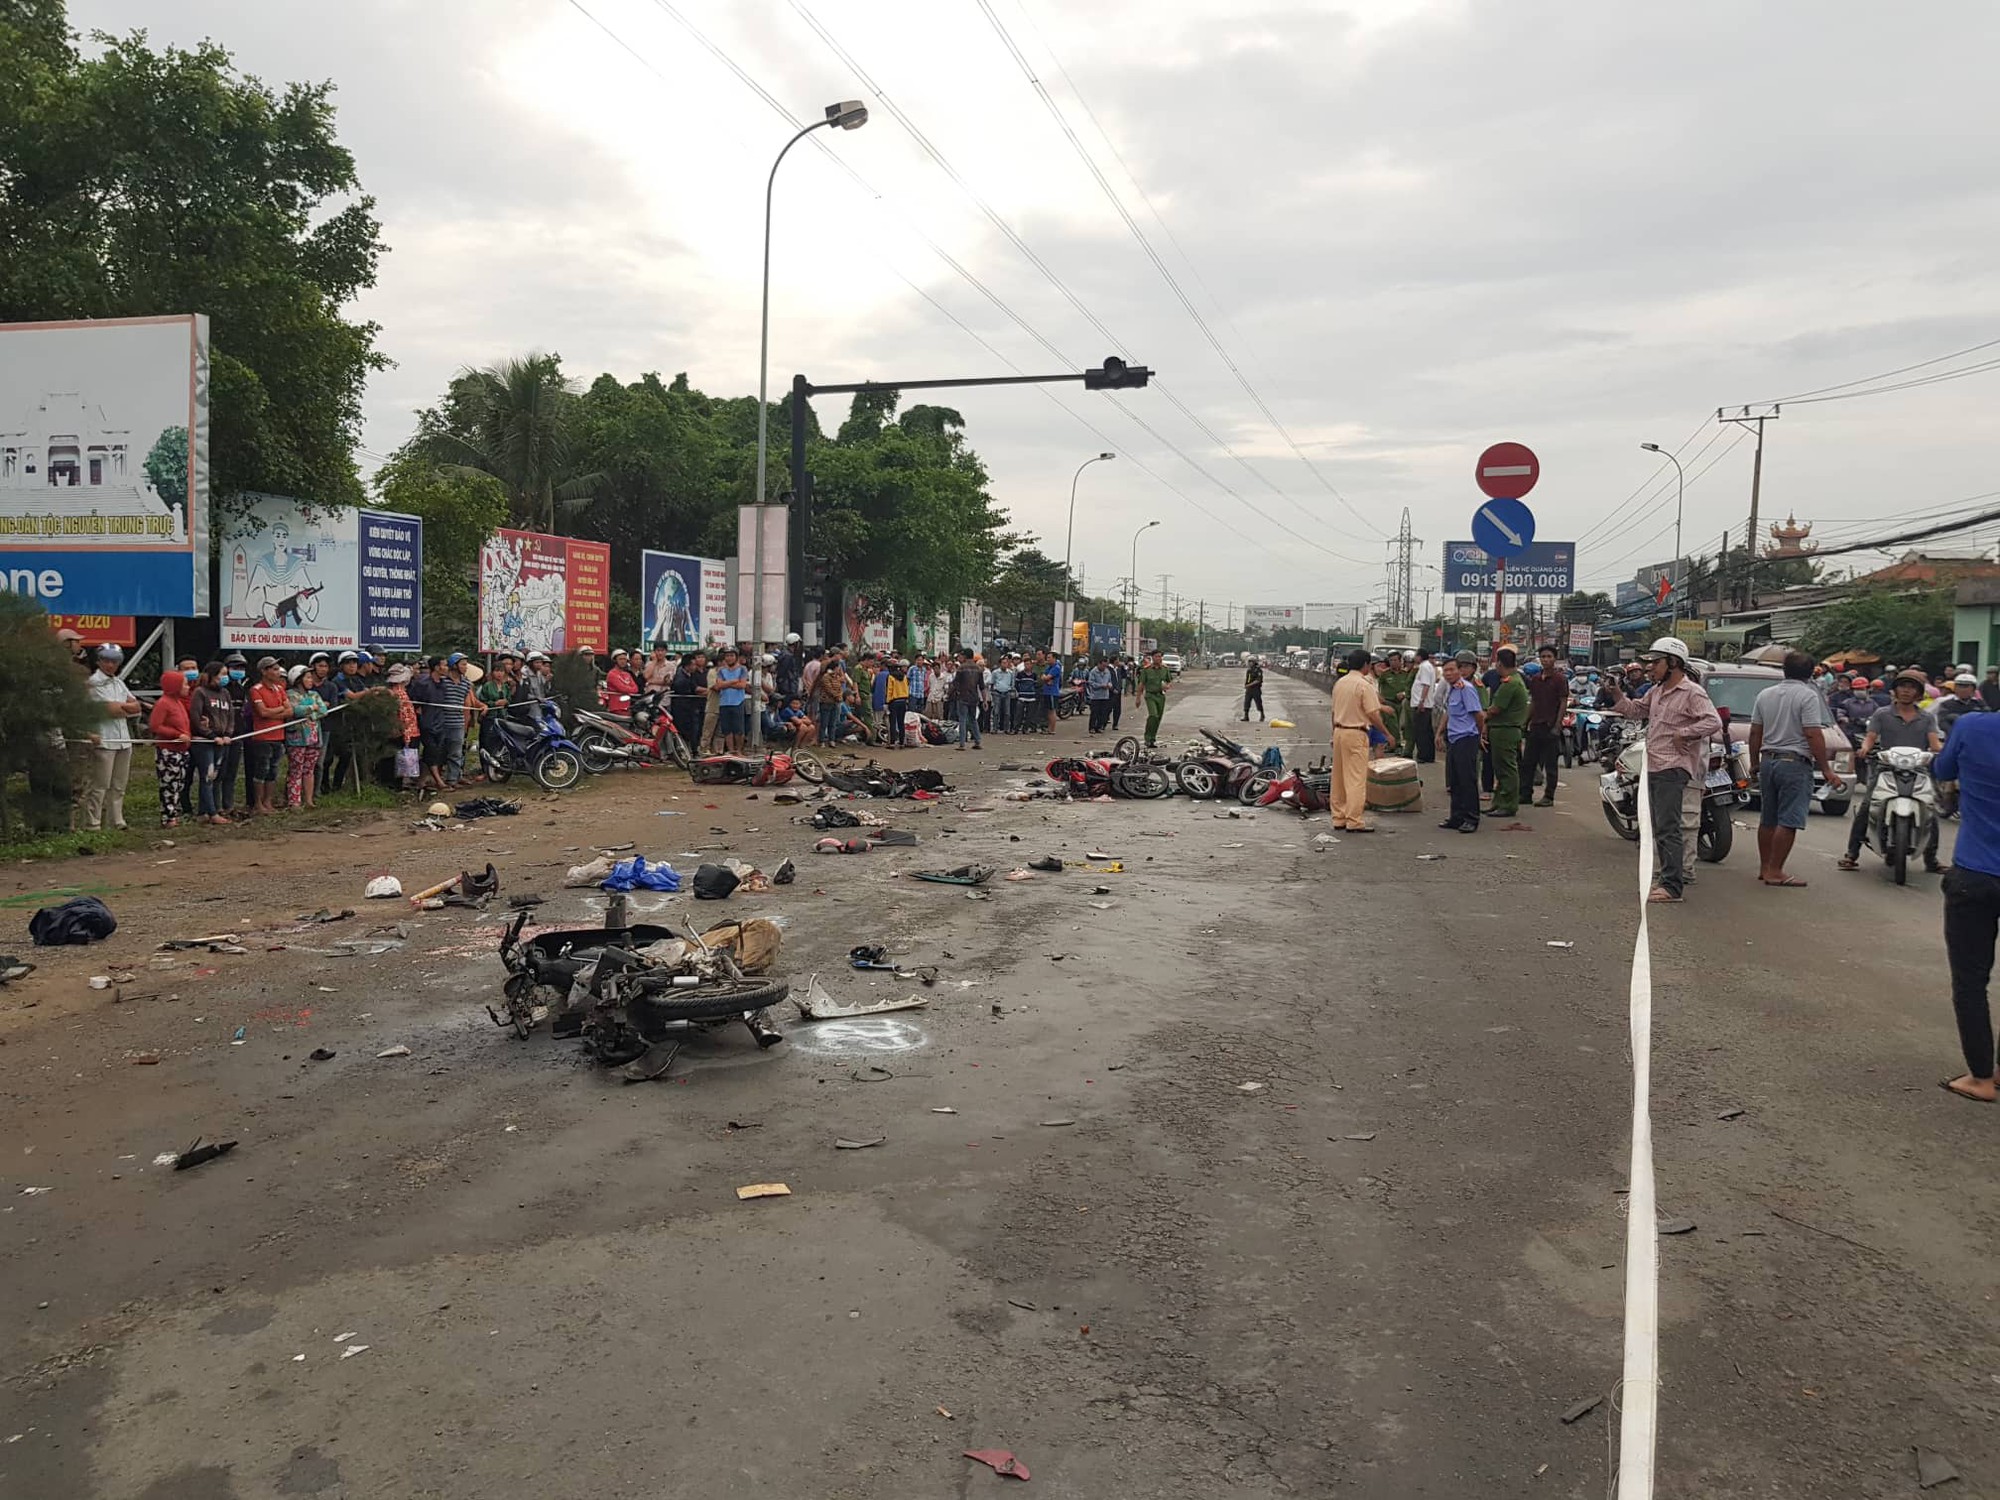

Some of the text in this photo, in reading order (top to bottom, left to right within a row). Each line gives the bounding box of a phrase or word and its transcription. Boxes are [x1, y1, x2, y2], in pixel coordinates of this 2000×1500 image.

[16, 511, 39, 535] DÂN
[41, 511, 61, 538] TỘC
[62, 508, 105, 535] NGUYỄN
[107, 515, 144, 535] TRUNG
[146, 513, 174, 539] TRỰC
[77, 615, 110, 629] 2020
[231, 631, 246, 643] BẢO
[258, 632, 270, 644] CHỦ
[339, 636, 352, 646] NAM
